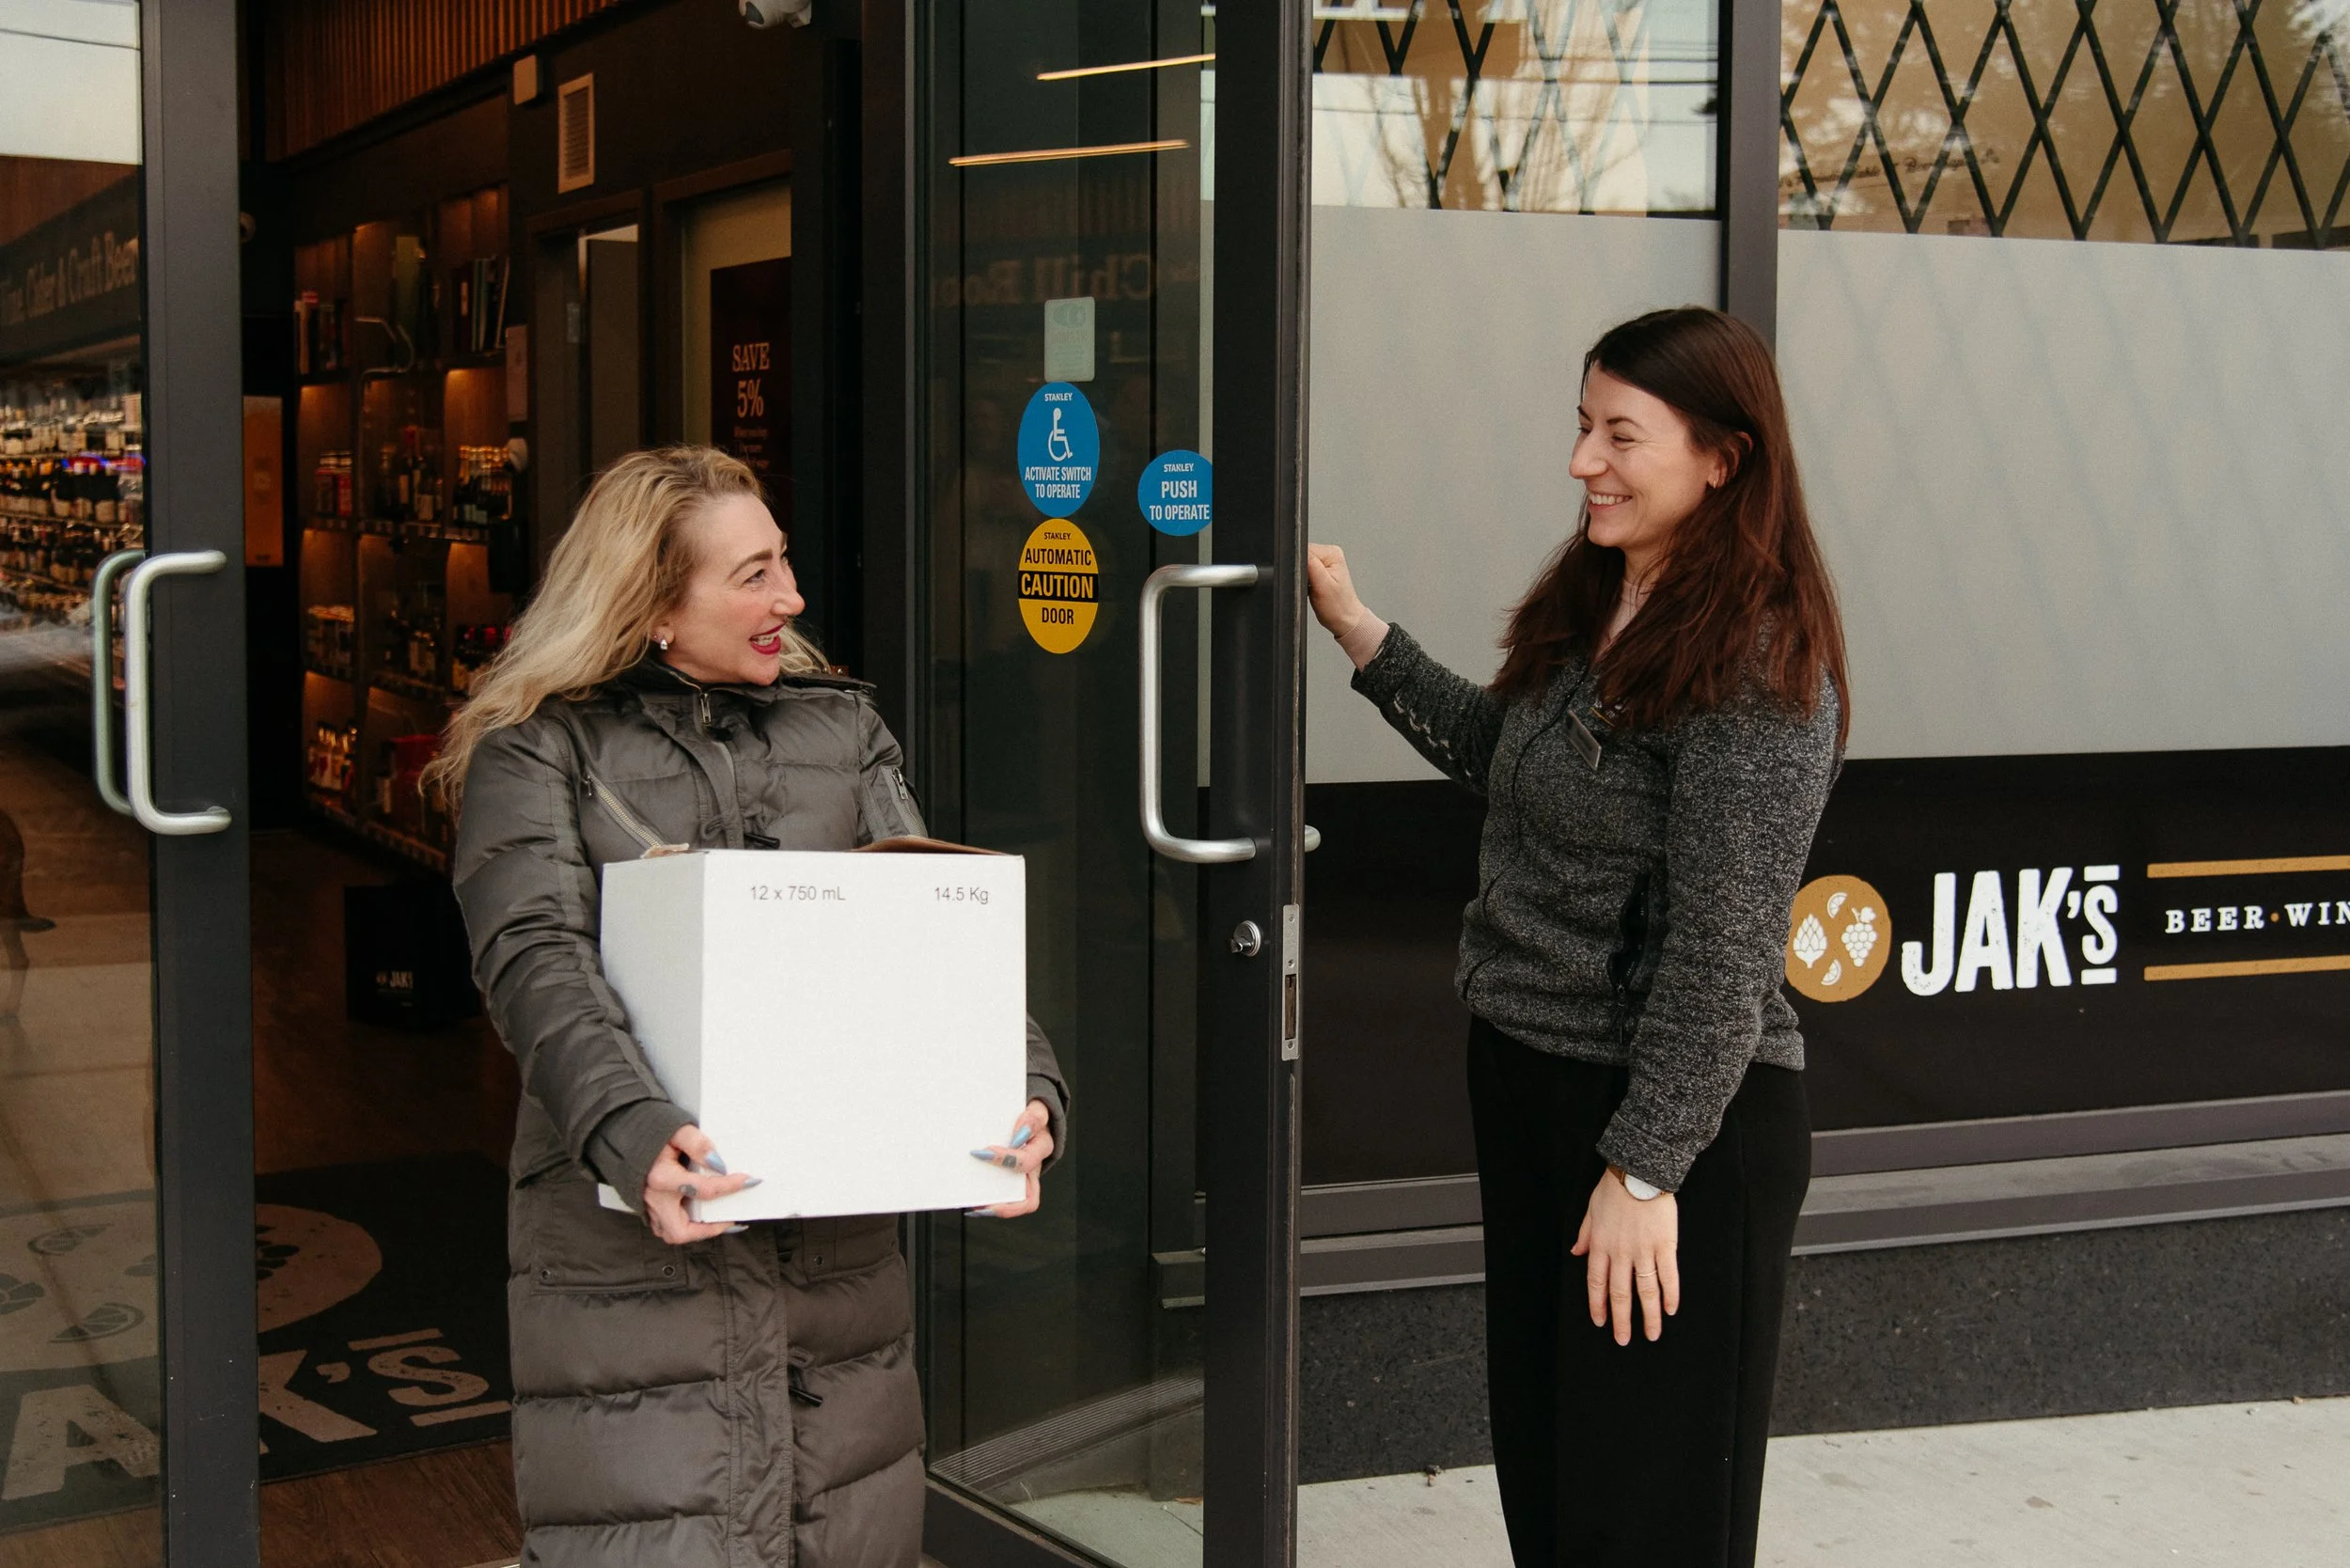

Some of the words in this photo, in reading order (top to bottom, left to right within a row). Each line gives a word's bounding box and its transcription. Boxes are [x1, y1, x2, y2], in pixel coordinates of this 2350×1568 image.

[732, 342, 770, 372] SAVE
[737, 378, 764, 418] 5%
[1044, 393, 1073, 401] STANLEY
[1025, 466, 1059, 481] ACTIVATE
[1061, 466, 1091, 481] SWITCH
[1164, 463, 1195, 473] STANLEY
[1035, 484, 1045, 498] TO
[1046, 483, 1080, 499] OPERATE
[1162, 480, 1198, 499] PUSH
[1149, 505, 1163, 521] TO
[1165, 504, 1211, 521] OPERATE
[1043, 532, 1072, 541] STANLEY
[1025, 548, 1092, 566] AUTOMATIC
[1021, 572, 1094, 599] CAUTION
[1042, 607, 1073, 625] DOOR
[751, 886, 769, 901] 12
[774, 888, 783, 901] x
[788, 886, 817, 901] 750
[822, 886, 846, 901] mL
[934, 886, 965, 902] 14.5
[970, 886, 989, 905] Kg
[2165, 905, 2265, 934] BEER
[1901, 865, 2120, 996] JAK'S
